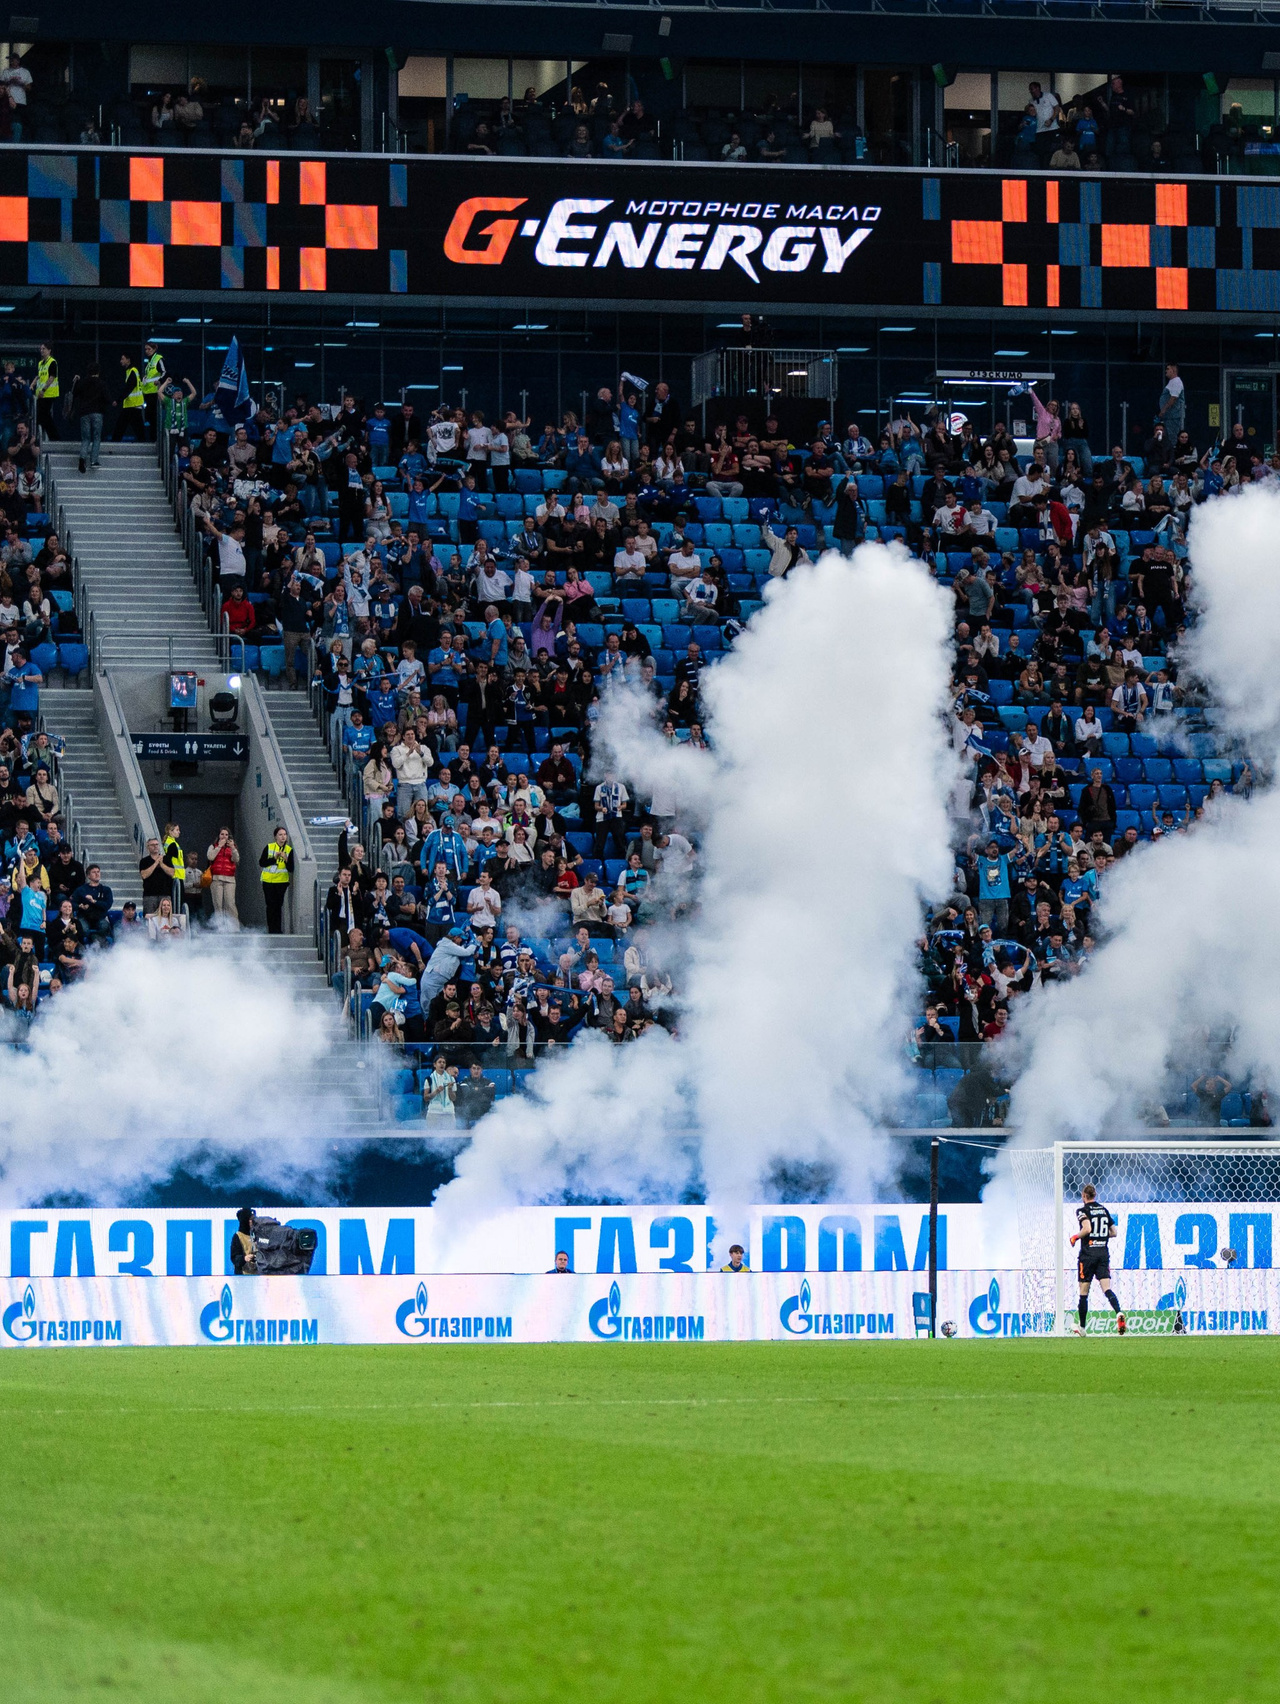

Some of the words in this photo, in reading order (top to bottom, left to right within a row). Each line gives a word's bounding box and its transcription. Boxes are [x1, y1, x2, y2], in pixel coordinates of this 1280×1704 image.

[627, 199, 780, 220] МОТОРНОЕ
[785, 204, 882, 221] МАСЛО
[1089, 1216, 1109, 1237] 16
[10, 1218, 415, 1275] ГАЗПОМ
[38, 1320, 122, 1341] ГАЗПРОМ
[235, 1318, 318, 1344] ГАЗПРОМ
[430, 1316, 512, 1338] ГАЗПРОМ
[623, 1316, 704, 1340] ГАЗПРОМ
[814, 1313, 894, 1334] ГАЗПРОМ
[1187, 1310, 1268, 1331] ГАЗПРОМ
